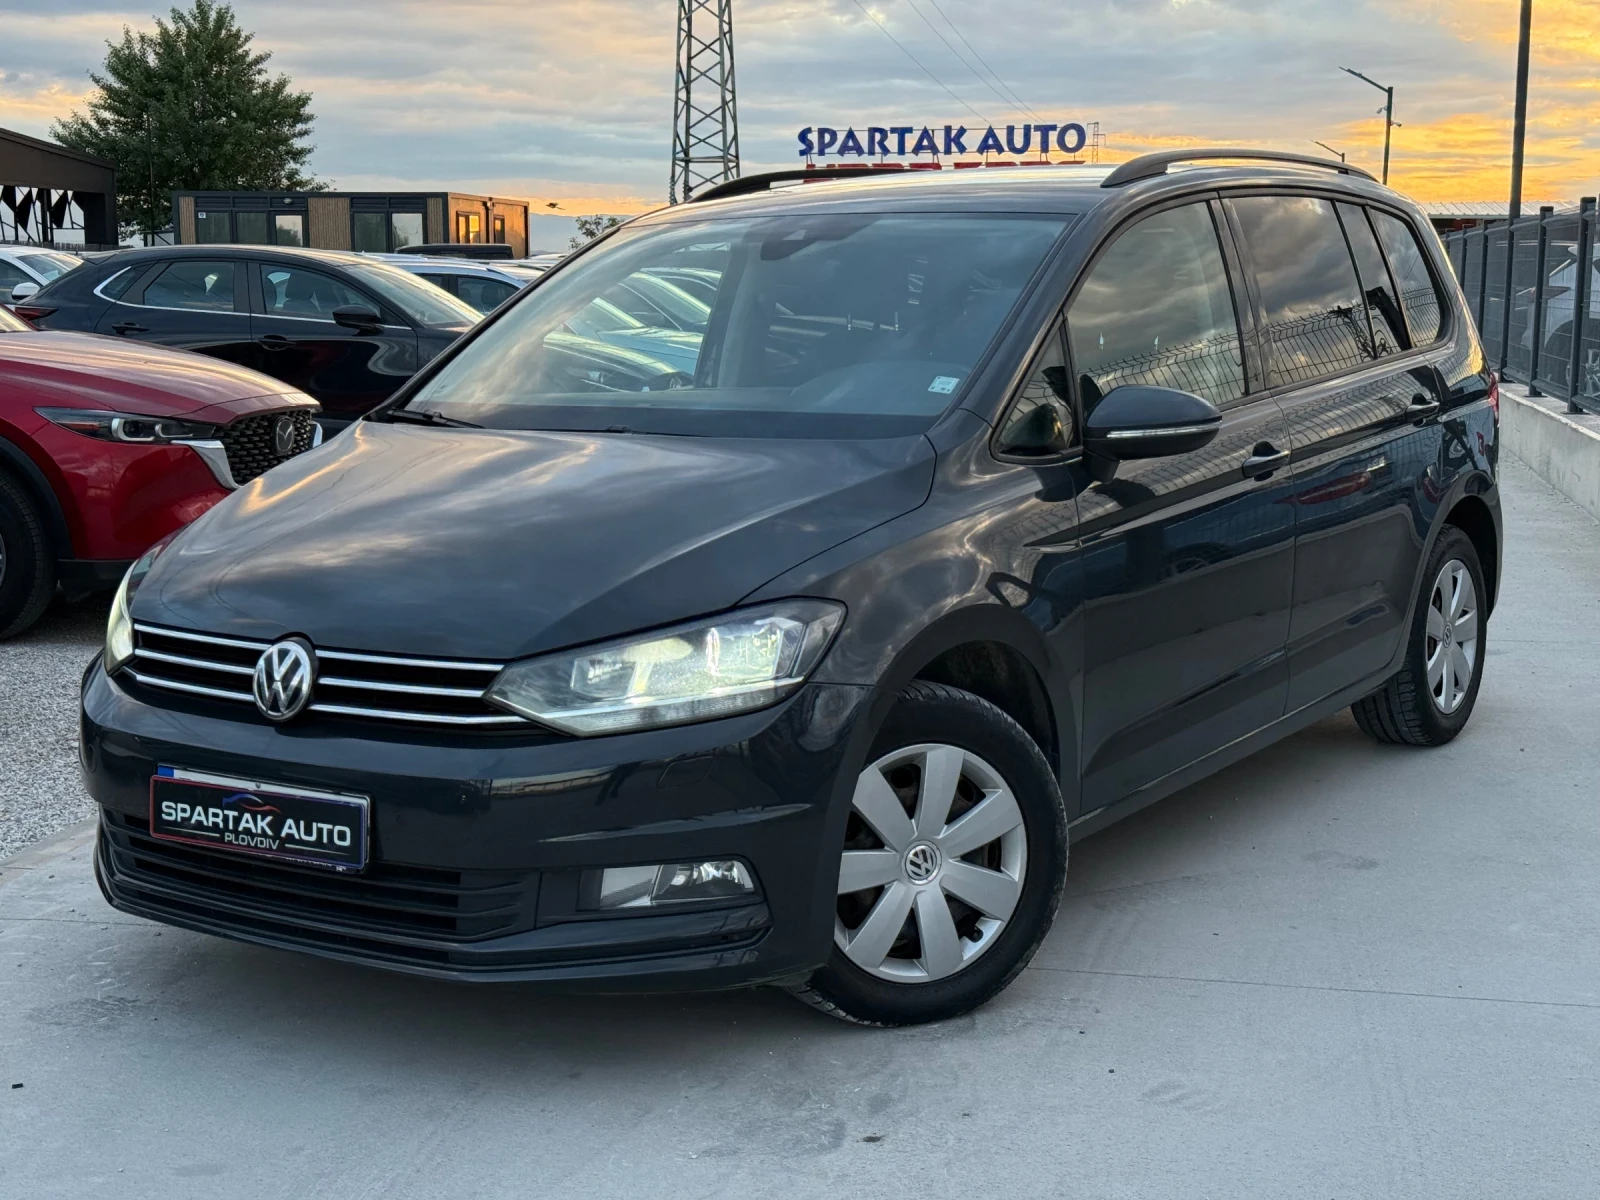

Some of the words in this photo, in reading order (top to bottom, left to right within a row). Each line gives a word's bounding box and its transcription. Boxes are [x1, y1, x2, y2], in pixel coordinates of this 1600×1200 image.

[797, 125, 968, 157] SPARTAK
[977, 122, 1086, 155] AUTO
[254, 641, 311, 719] VW
[161, 801, 275, 836] SPARTAK
[280, 818, 351, 847] AUTO
[224, 831, 279, 850] PLOVDIV
